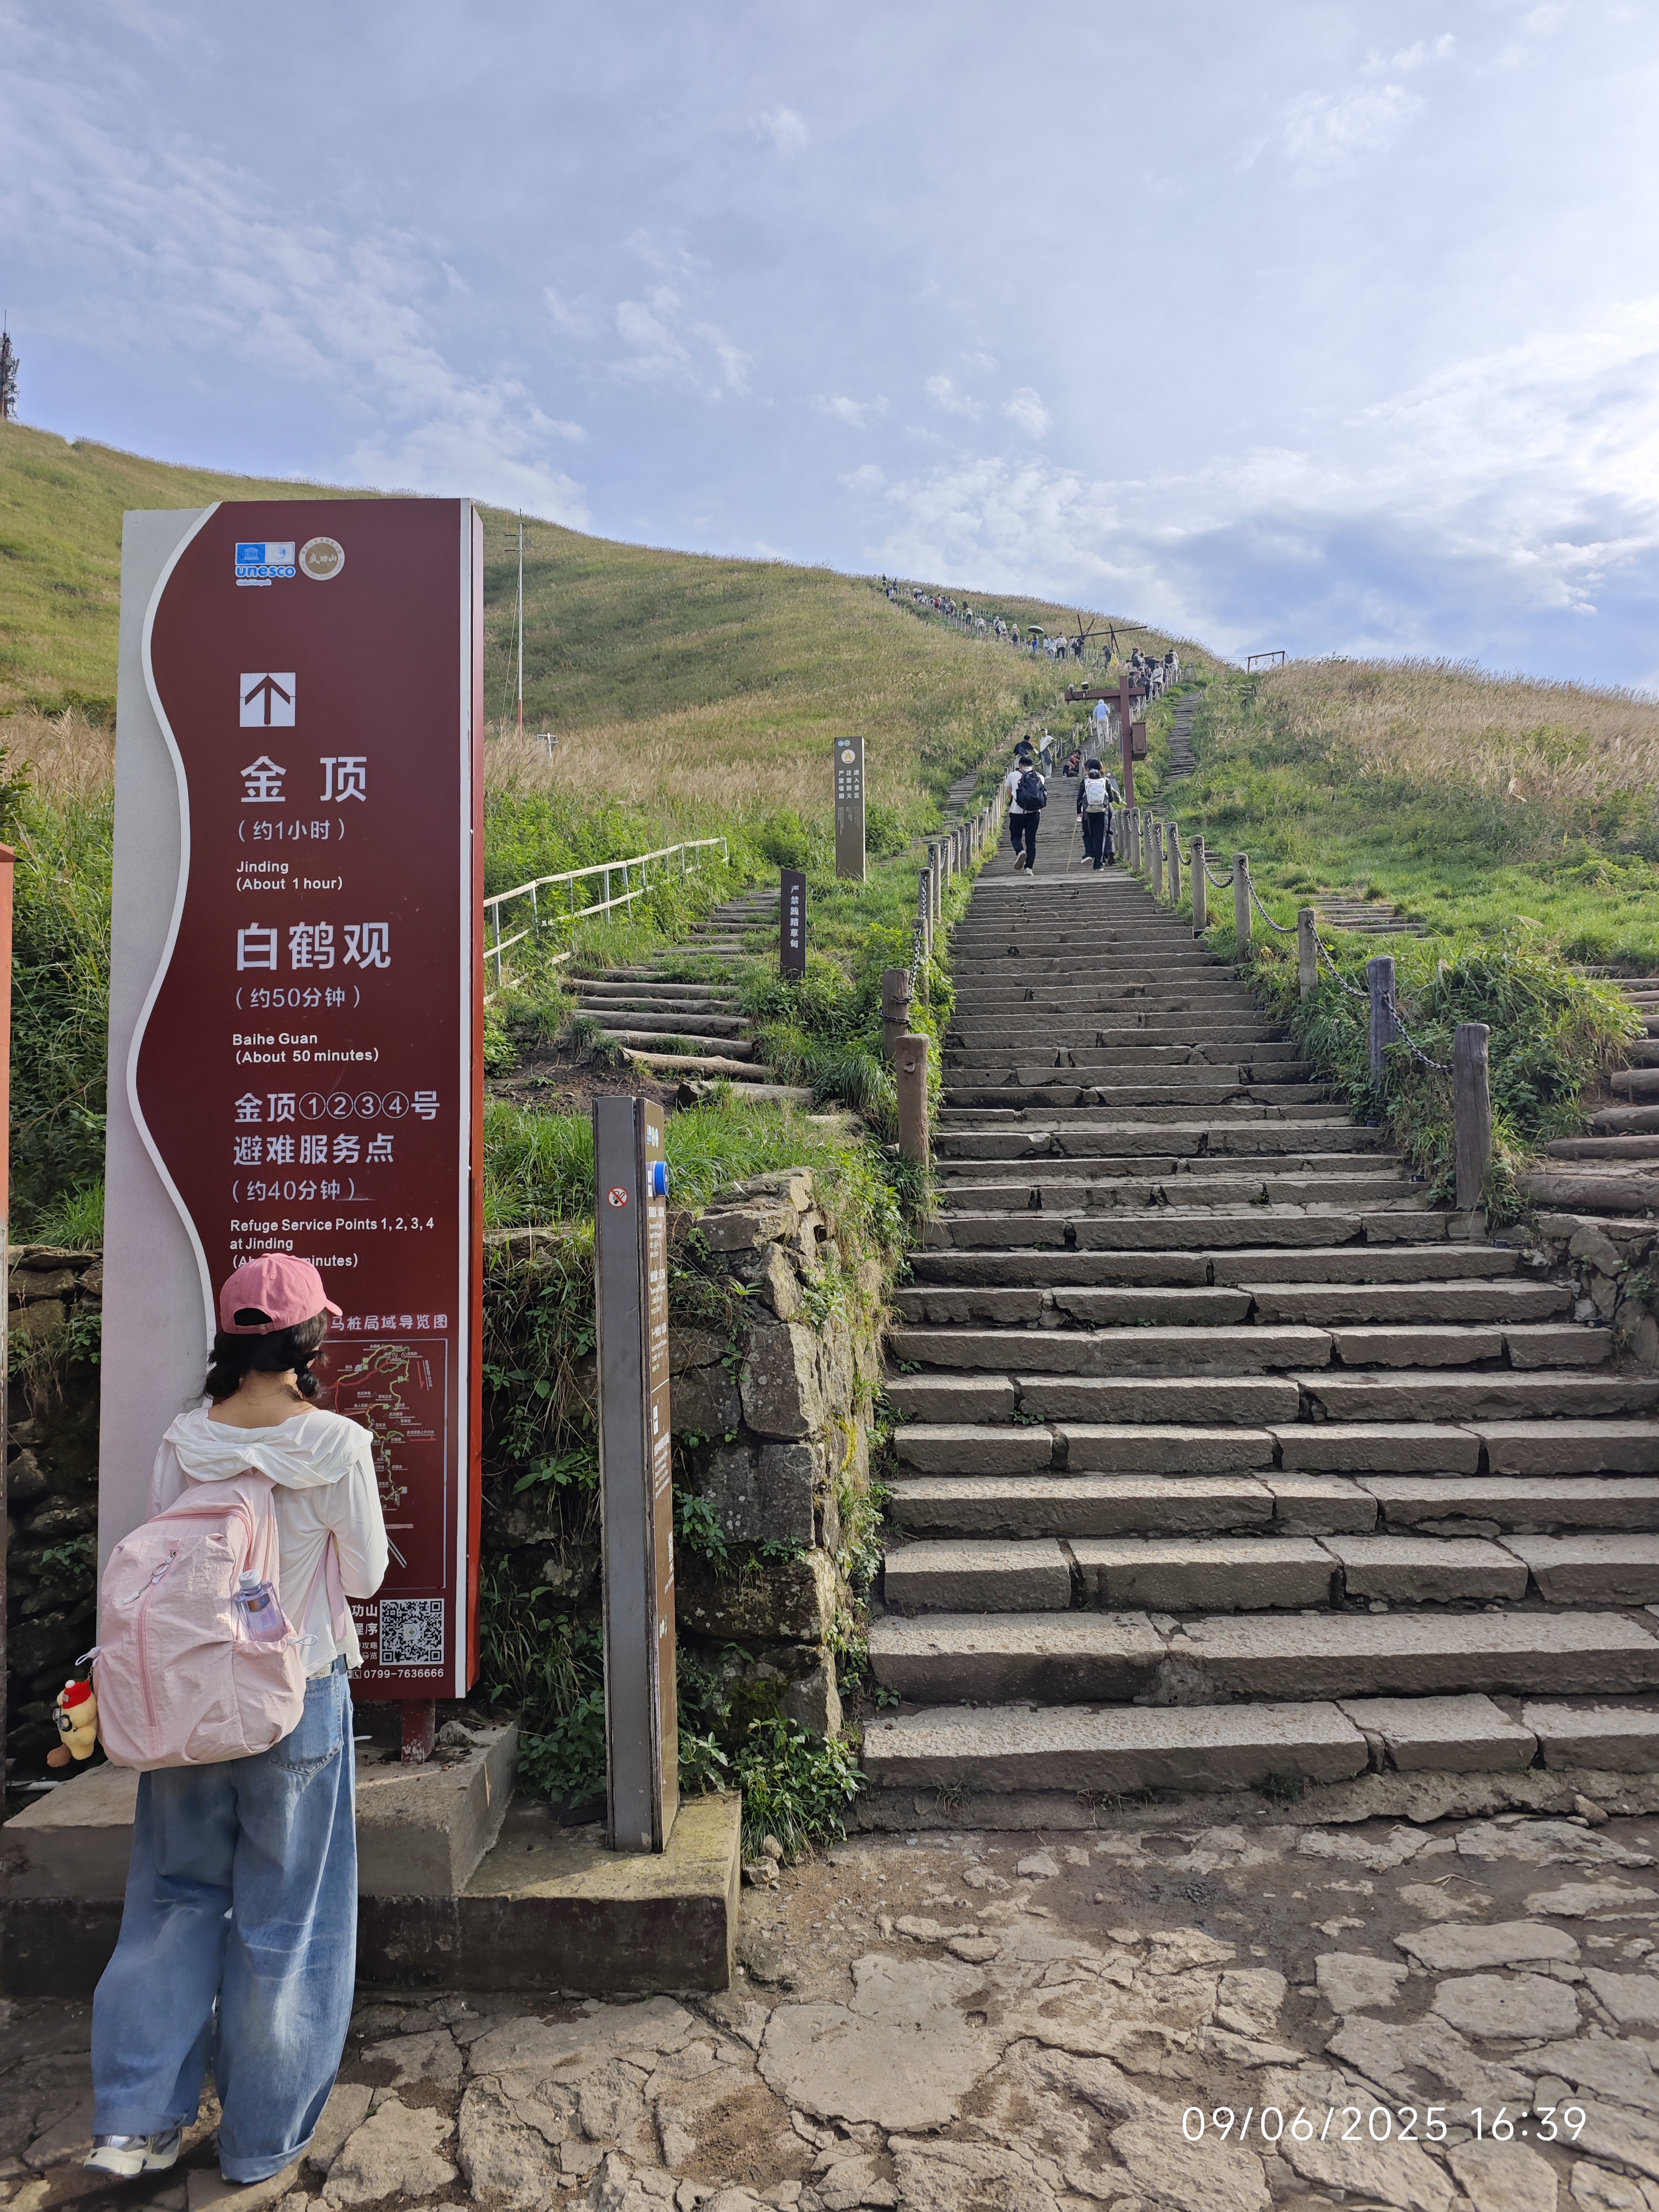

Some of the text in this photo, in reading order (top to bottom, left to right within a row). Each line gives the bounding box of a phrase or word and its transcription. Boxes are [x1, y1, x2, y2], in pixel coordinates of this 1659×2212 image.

[308, 552, 337, 565] 武功山
[237, 567, 295, 577] unesco
[238, 818, 345, 842] （约1小时）
[237, 861, 289, 874] Jinding
[237, 876, 342, 891] (About 1 hour)
[790, 885, 799, 948] 严禁践踏草甸
[237, 921, 392, 970] 白鹤观
[236, 985, 360, 1009] （约50分钟）
[233, 1033, 318, 1046] Baihe Guan
[236, 1048, 379, 1064] (About 50 minutes)
[233, 1133, 394, 1165] 避难服务点
[232, 1178, 355, 1203] （约40分钟）
[231, 1217, 434, 1233] Refuge Service Points 1, 2, 3, 4
[230, 1238, 293, 1251] at Jinding
[330, 1314, 448, 1331] 马桩局域导览图
[349, 1603, 377, 1617] 功山
[359, 1642, 378, 1650] 攻略
[363, 1669, 444, 1678] 0799-7636666
